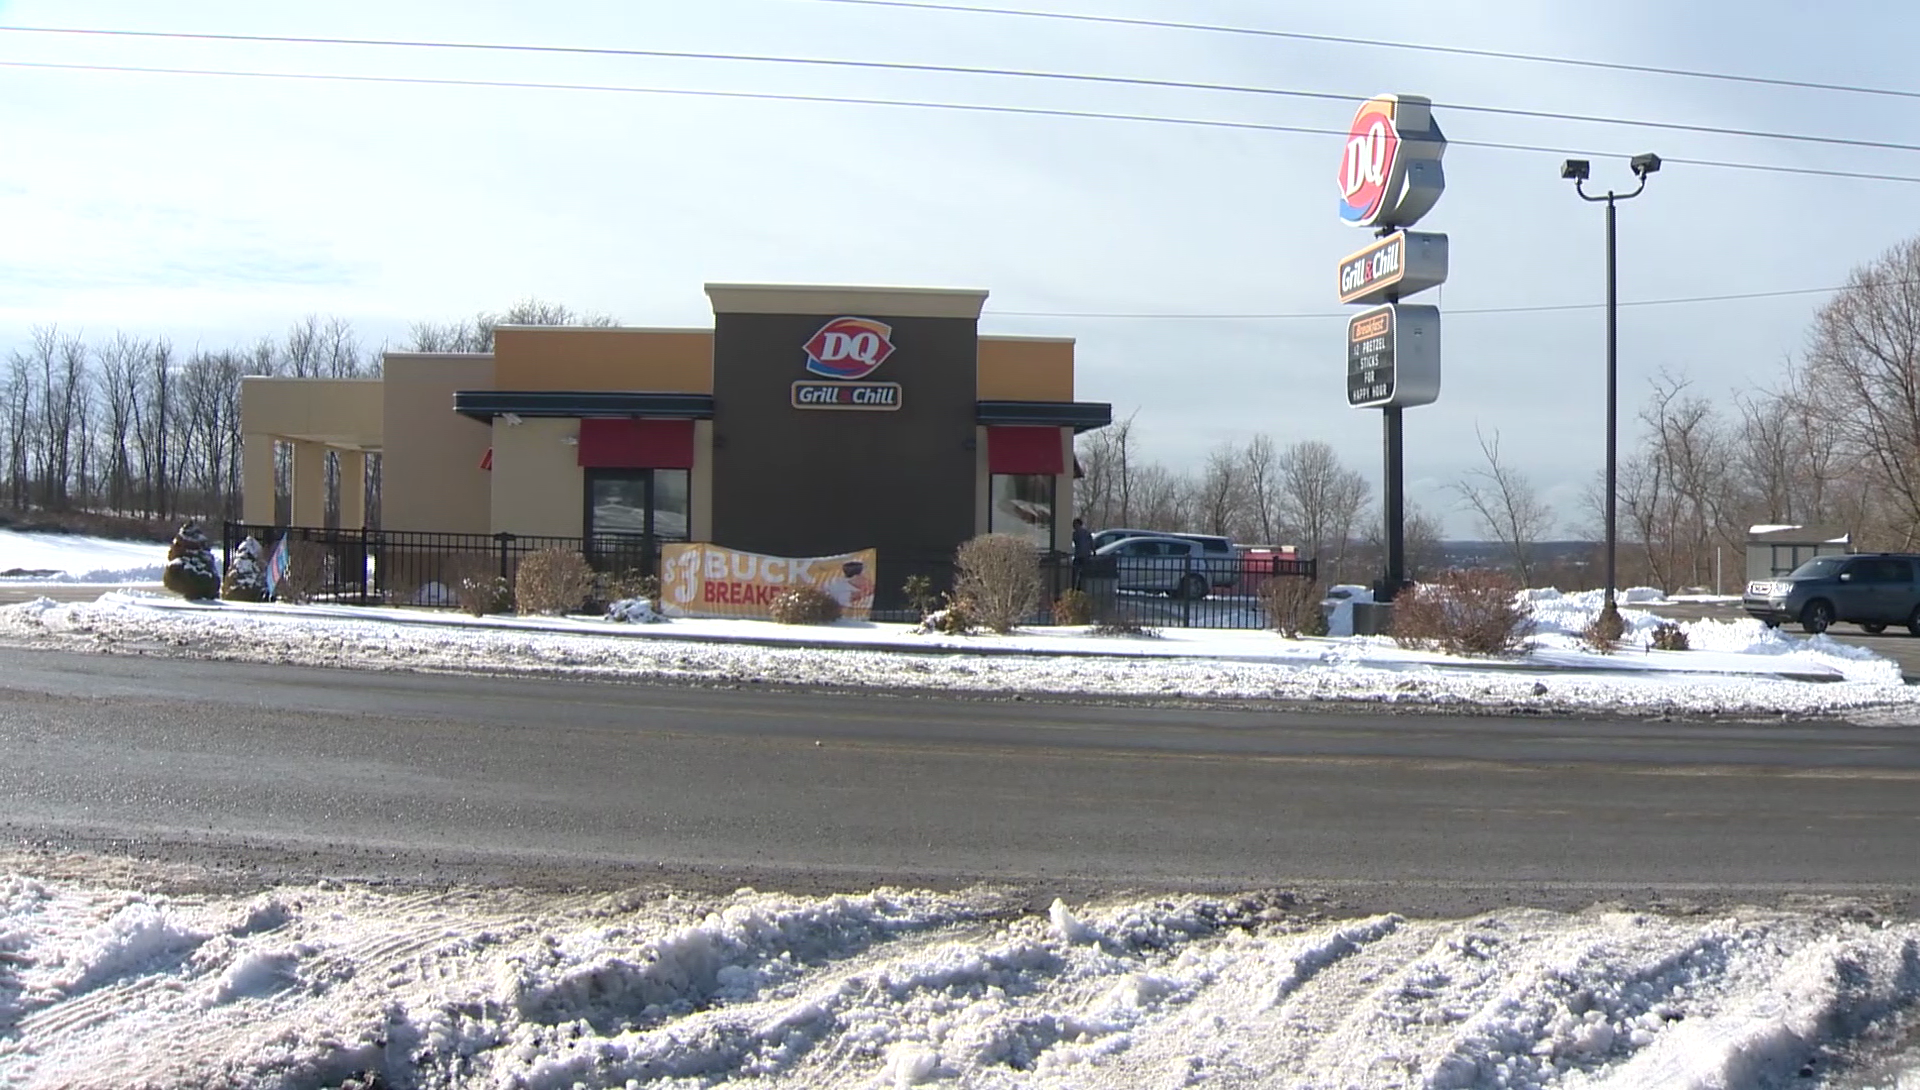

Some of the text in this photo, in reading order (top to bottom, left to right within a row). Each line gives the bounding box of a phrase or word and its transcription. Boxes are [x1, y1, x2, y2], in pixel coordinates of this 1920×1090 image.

[1346, 121, 1386, 197] DQ
[1342, 242, 1399, 292] Grill & Chill
[820, 332, 880, 365] DQ
[1363, 337, 1386, 354] PRETZEL
[1360, 354, 1379, 370] STICKS
[1364, 370, 1375, 384] FOR
[799, 387, 839, 403] Grill
[852, 388, 894, 404] Chill
[704, 551, 816, 584] BUCK
